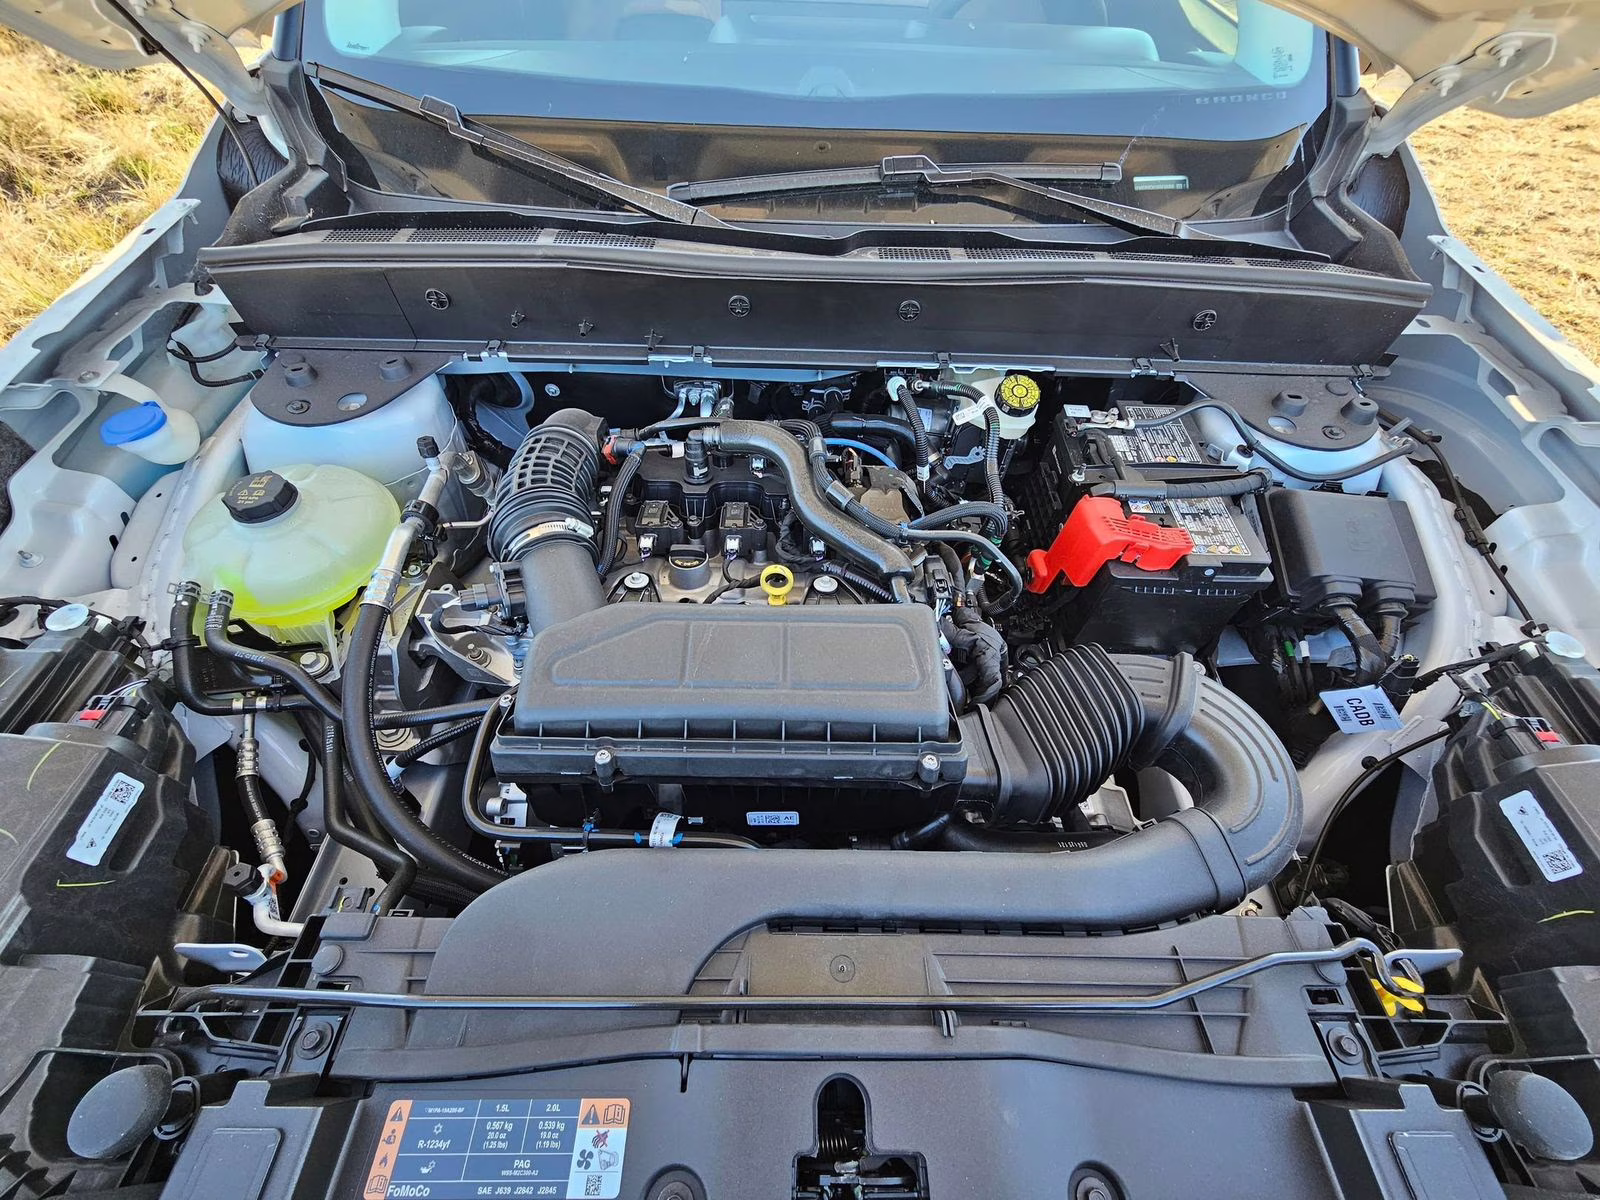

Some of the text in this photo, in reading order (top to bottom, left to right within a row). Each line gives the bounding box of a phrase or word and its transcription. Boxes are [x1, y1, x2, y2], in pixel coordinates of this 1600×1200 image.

[1195, 91, 1287, 104] BRONCO
[1346, 698, 1375, 726] CADB
[496, 1104, 510, 1112] 1.5L
[546, 1104, 560, 1112] 2.0L
[486, 1121, 513, 1132] 0.567 kg
[538, 1121, 565, 1132] 0.539 kg
[417, 1139, 451, 1151] R-1234yf
[483, 1141, 508, 1150] (1.25 lbs)
[536, 1141, 561, 1150] (1.19 lbs)
[513, 1159, 531, 1169] PAG
[386, 1184, 430, 1198] FoMoCo
[477, 1186, 557, 1195] SAE J639 J2842 J2845
